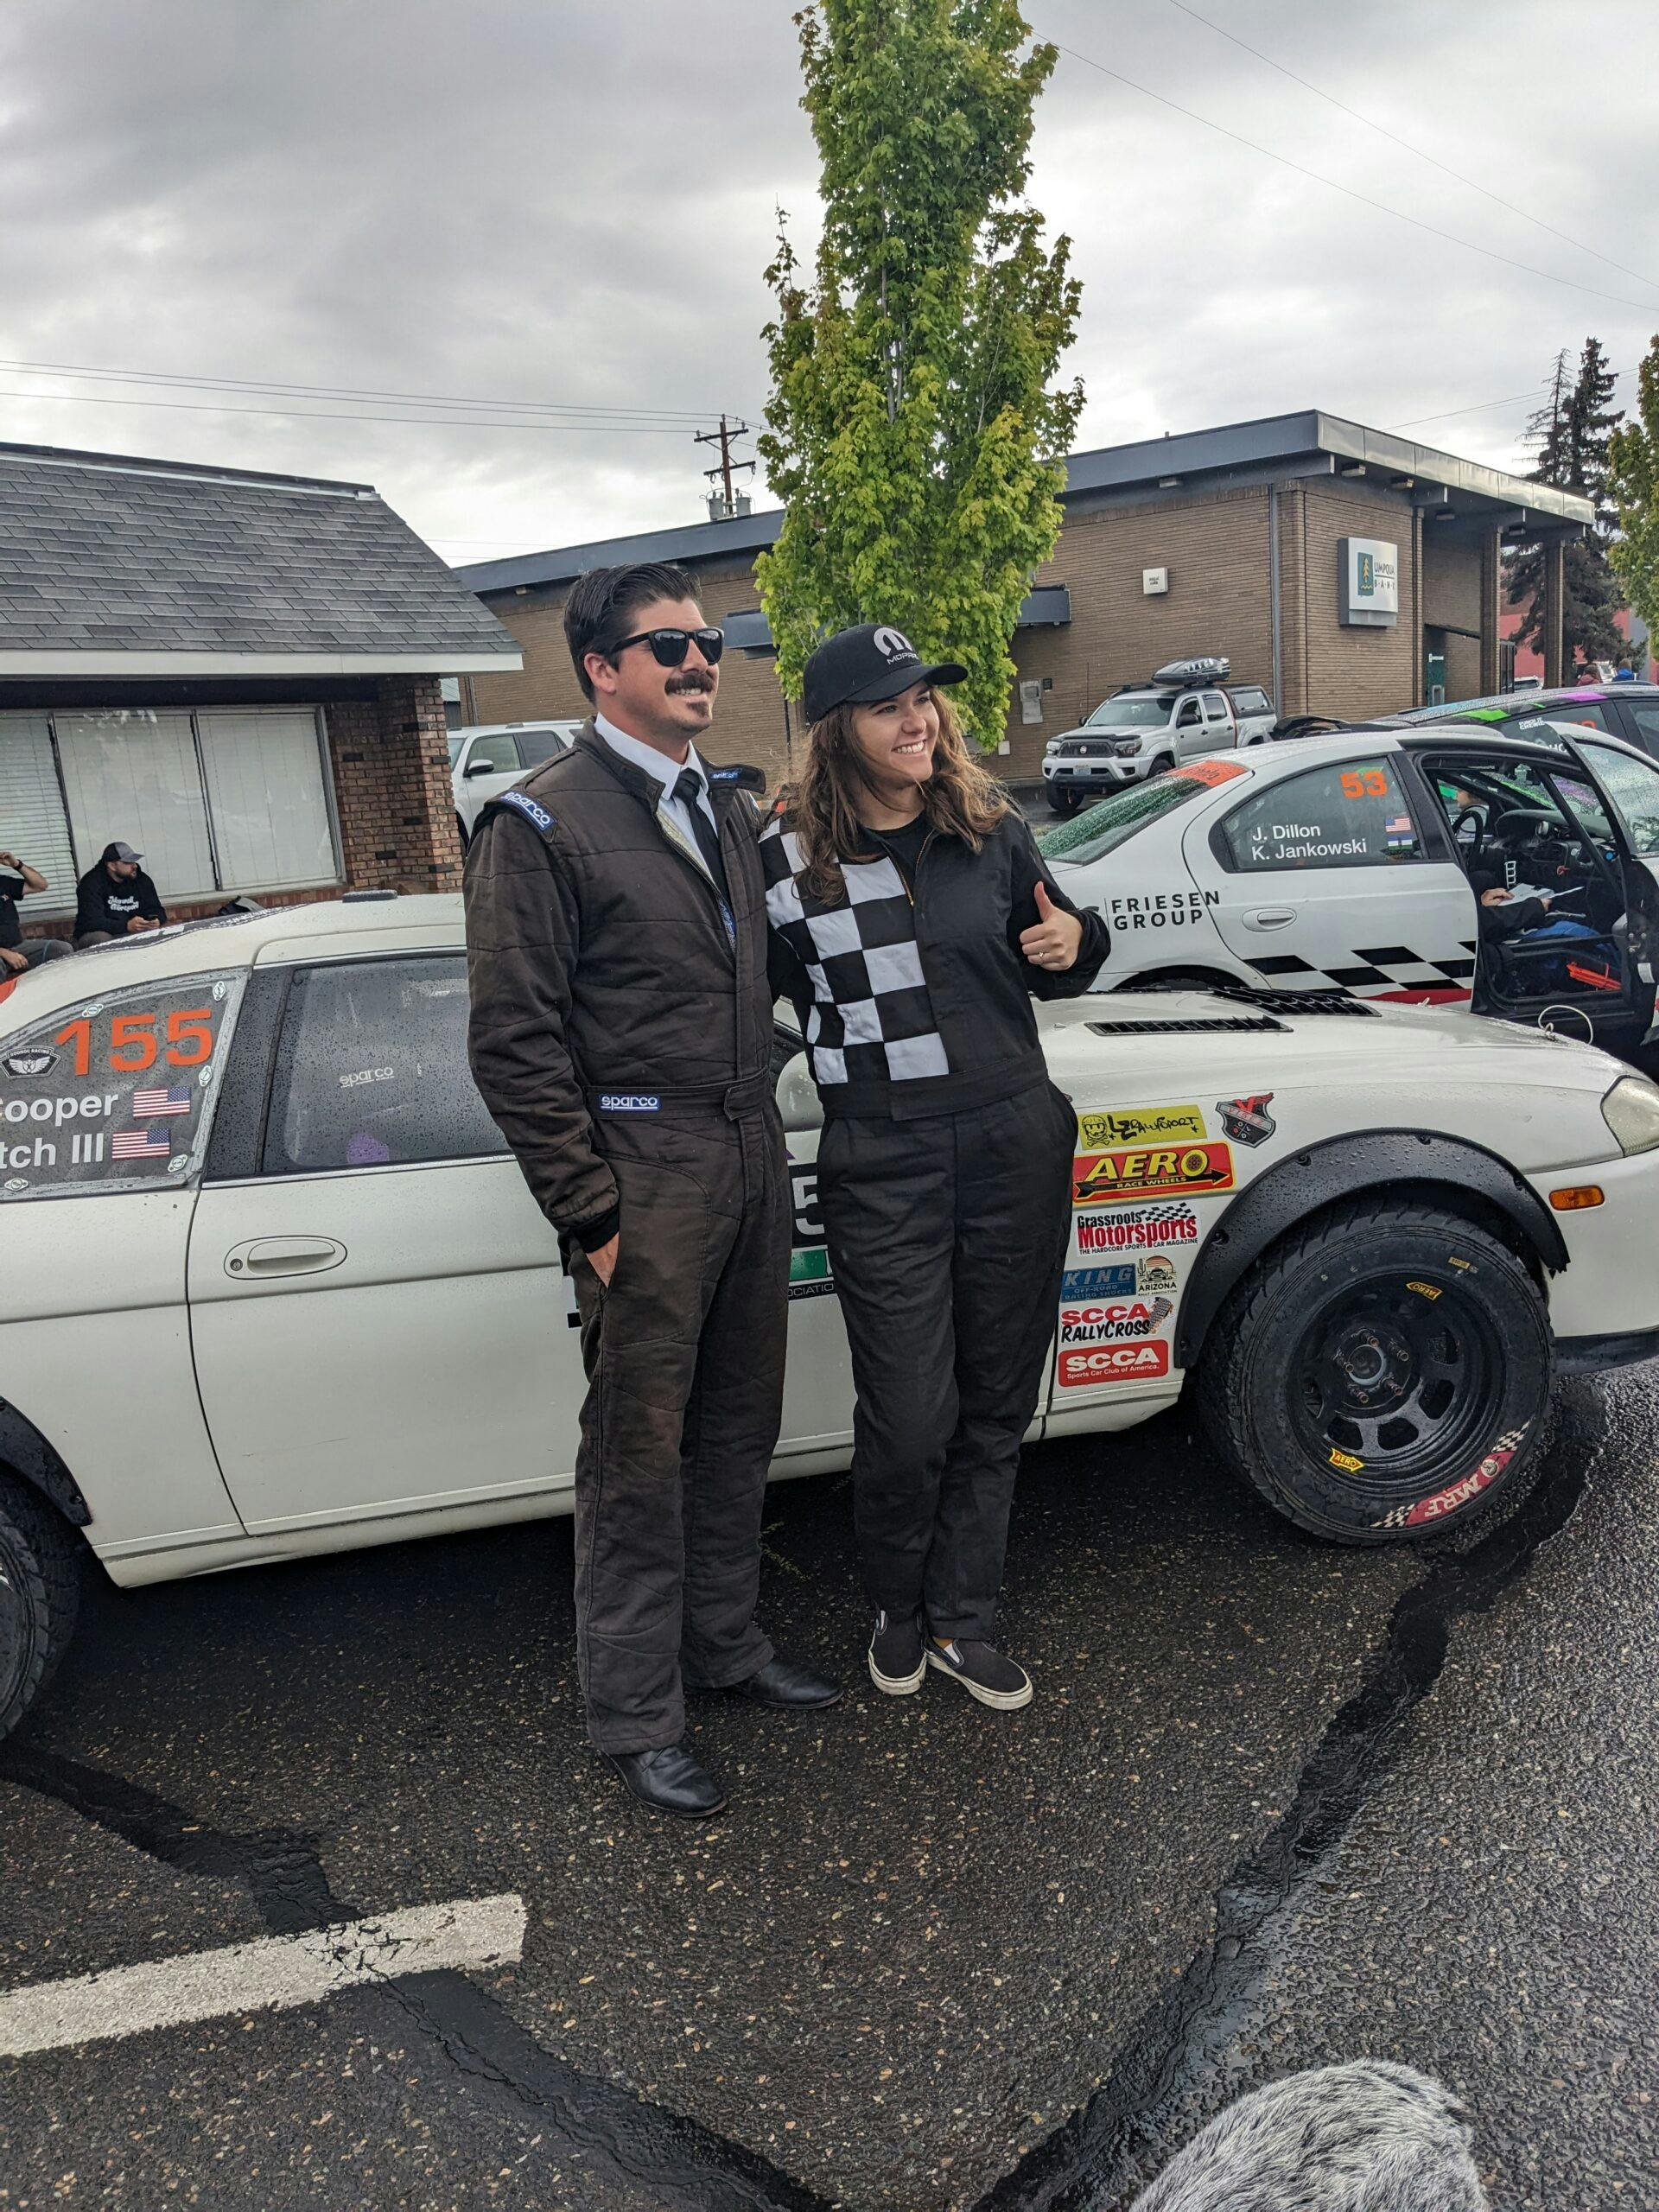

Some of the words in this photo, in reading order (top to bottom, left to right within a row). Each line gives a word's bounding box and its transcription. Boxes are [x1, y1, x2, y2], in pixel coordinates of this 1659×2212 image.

[1340, 771, 1388, 799] 53
[505, 792, 550, 825] sparco
[1253, 827, 1268, 842] J.
[1272, 823, 1321, 840] Dillon
[1252, 846, 1269, 861] K.
[1274, 838, 1367, 860] Jankowski
[1111, 890, 1220, 913] FRIESEN
[1114, 909, 1203, 931] GROUP
[55, 1008, 213, 1077] 155
[339, 1066, 394, 1086] sparco
[0, 1094, 119, 1127] ooper
[601, 1096, 658, 1110] sparco
[1084, 1148, 1208, 1183] AERO
[1116, 1180, 1144, 1189] RACE
[1146, 1176, 1187, 1186] WHEELS
[1077, 1211, 1142, 1228] Grassroots
[1077, 1217, 1198, 1249] Motorsports
[1091, 1245, 1123, 1254] HARDCORE
[1166, 1237, 1198, 1247] MAGAZINE
[1065, 1267, 1133, 1286] KING
[1138, 1281, 1177, 1292] ARIZONA
[1061, 1301, 1150, 1326] SCCA
[1066, 1347, 1160, 1372] SCCA
[1067, 1371, 1089, 1380] Sports
[1334, 1455, 1357, 1467] AERO
[1424, 1473, 1482, 1518] MRF
